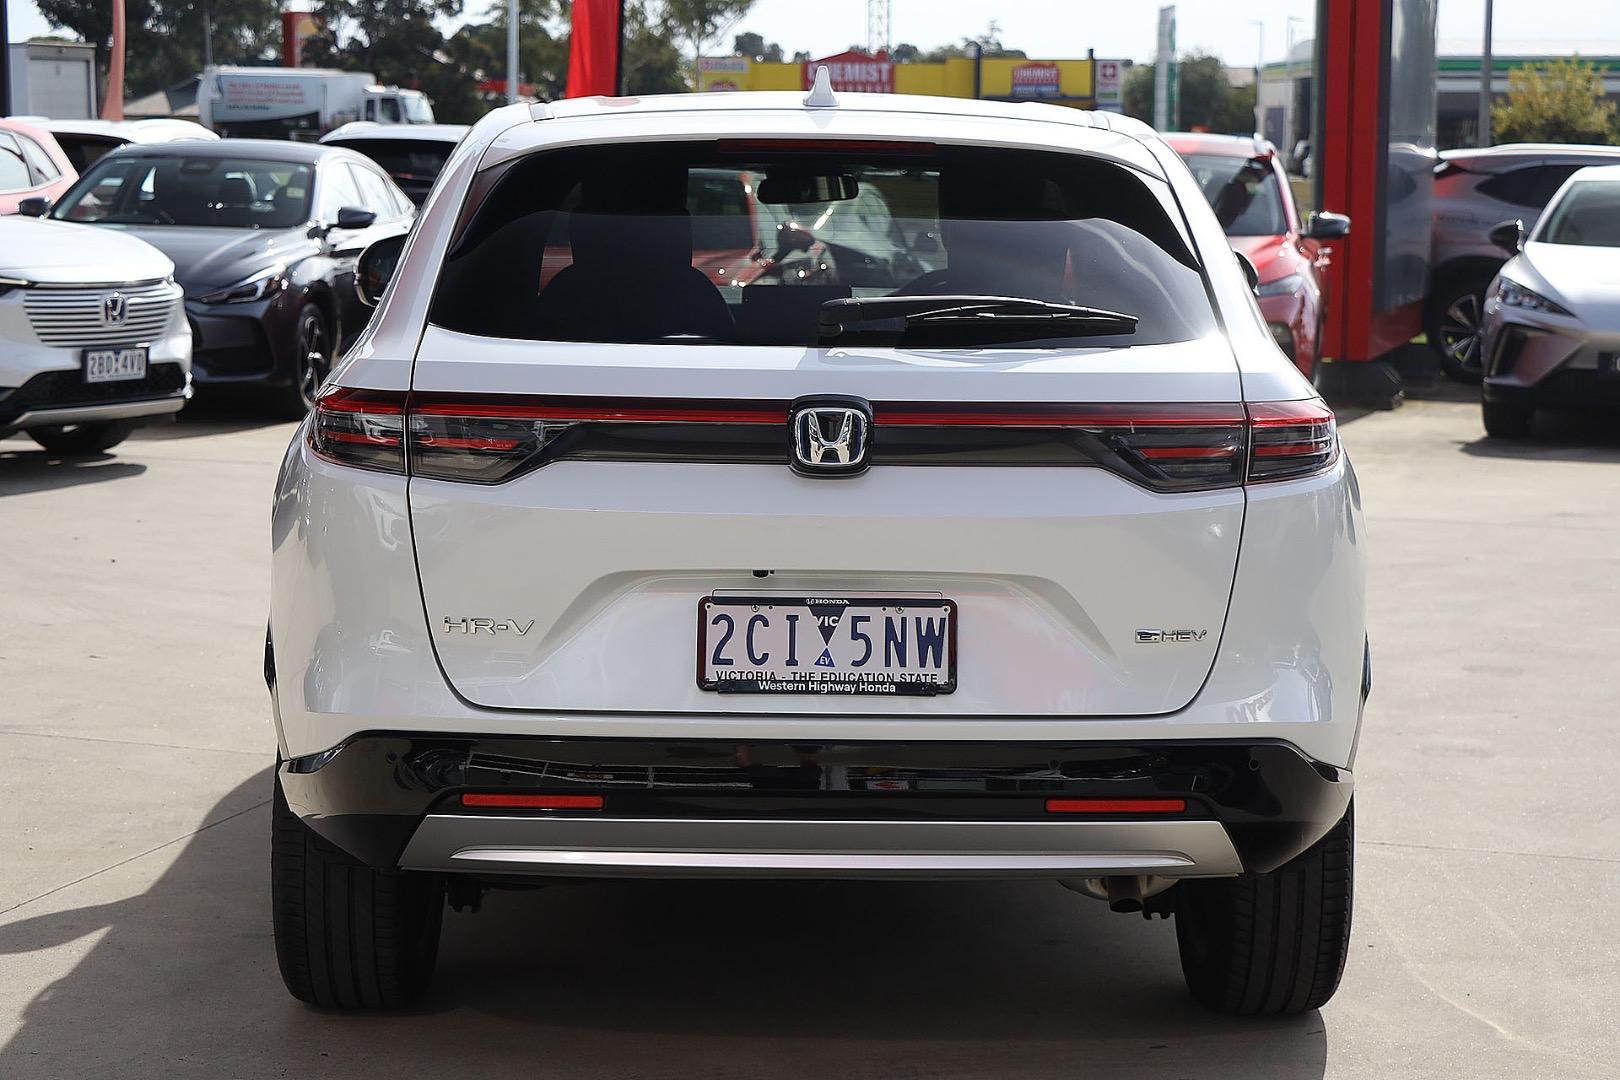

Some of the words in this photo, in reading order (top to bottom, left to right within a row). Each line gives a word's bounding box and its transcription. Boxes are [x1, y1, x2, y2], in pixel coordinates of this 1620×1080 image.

[444, 616, 535, 636] HR-V
[815, 615, 839, 627] VIC
[850, 615, 947, 669] 5NW
[819, 656, 831, 665] EV
[715, 671, 776, 681] VICTORIA
[791, 672, 816, 682] THE
[820, 673, 895, 683] EDUCATION
[900, 674, 938, 684] STATE
[758, 681, 806, 692] Western
[808, 681, 856, 695] Highway
[859, 683, 896, 693] Honda
